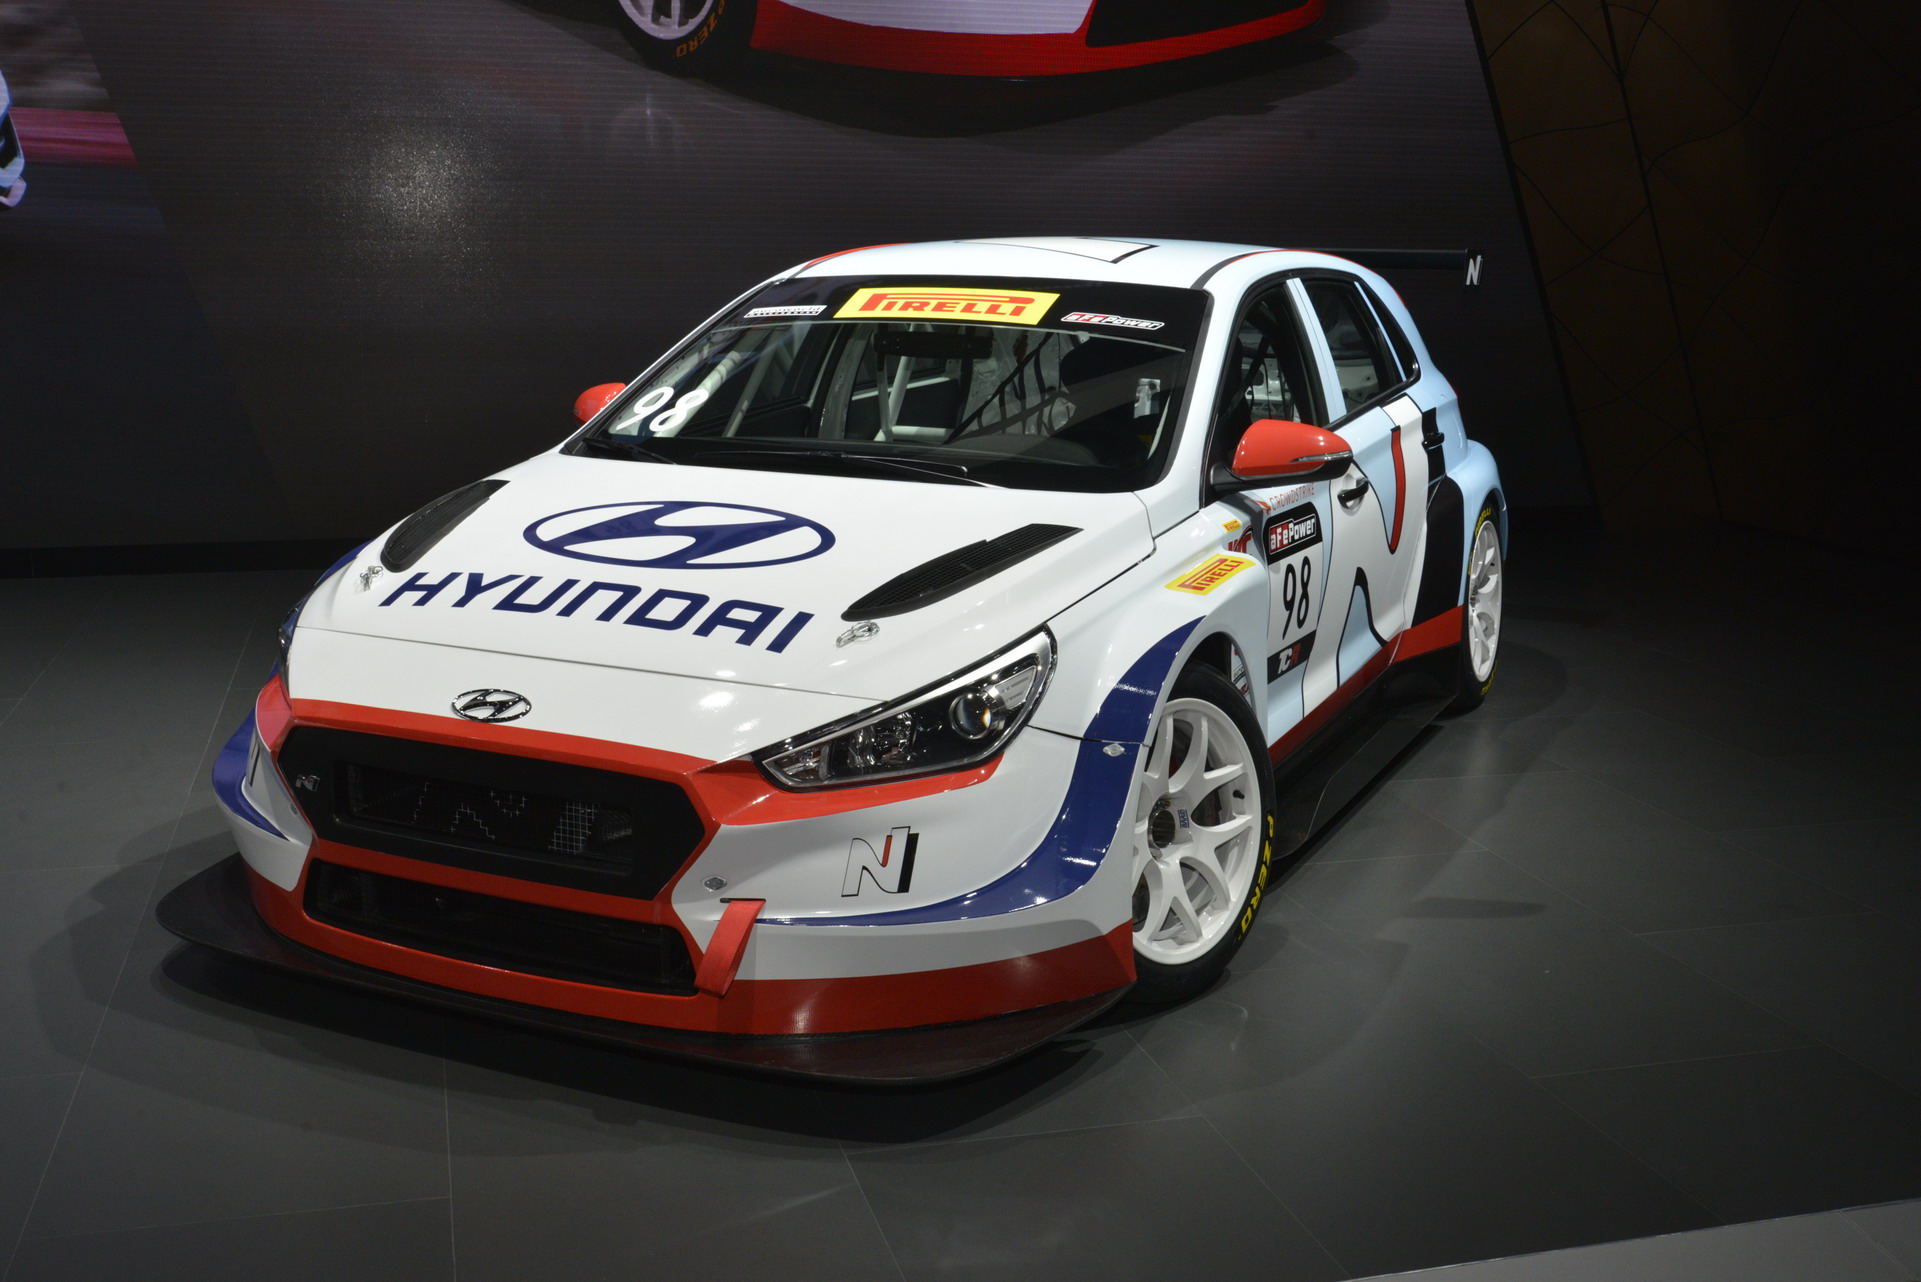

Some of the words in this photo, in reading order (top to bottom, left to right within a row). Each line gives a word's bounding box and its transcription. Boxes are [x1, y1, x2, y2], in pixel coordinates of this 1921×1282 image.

[676, 11, 718, 57] ZERO
[1466, 255, 1484, 285] N
[858, 293, 1035, 317] PIRELLI
[616, 387, 709, 432] 98
[1269, 483, 1315, 511] CROWDSTRIKE
[1270, 518, 1315, 549] aFePower
[1176, 558, 1244, 591] PIRELLI
[378, 572, 815, 654] HYUNDAI
[1282, 556, 1312, 640] 98
[841, 826, 919, 897] N
[1241, 840, 1272, 934] ZERO
